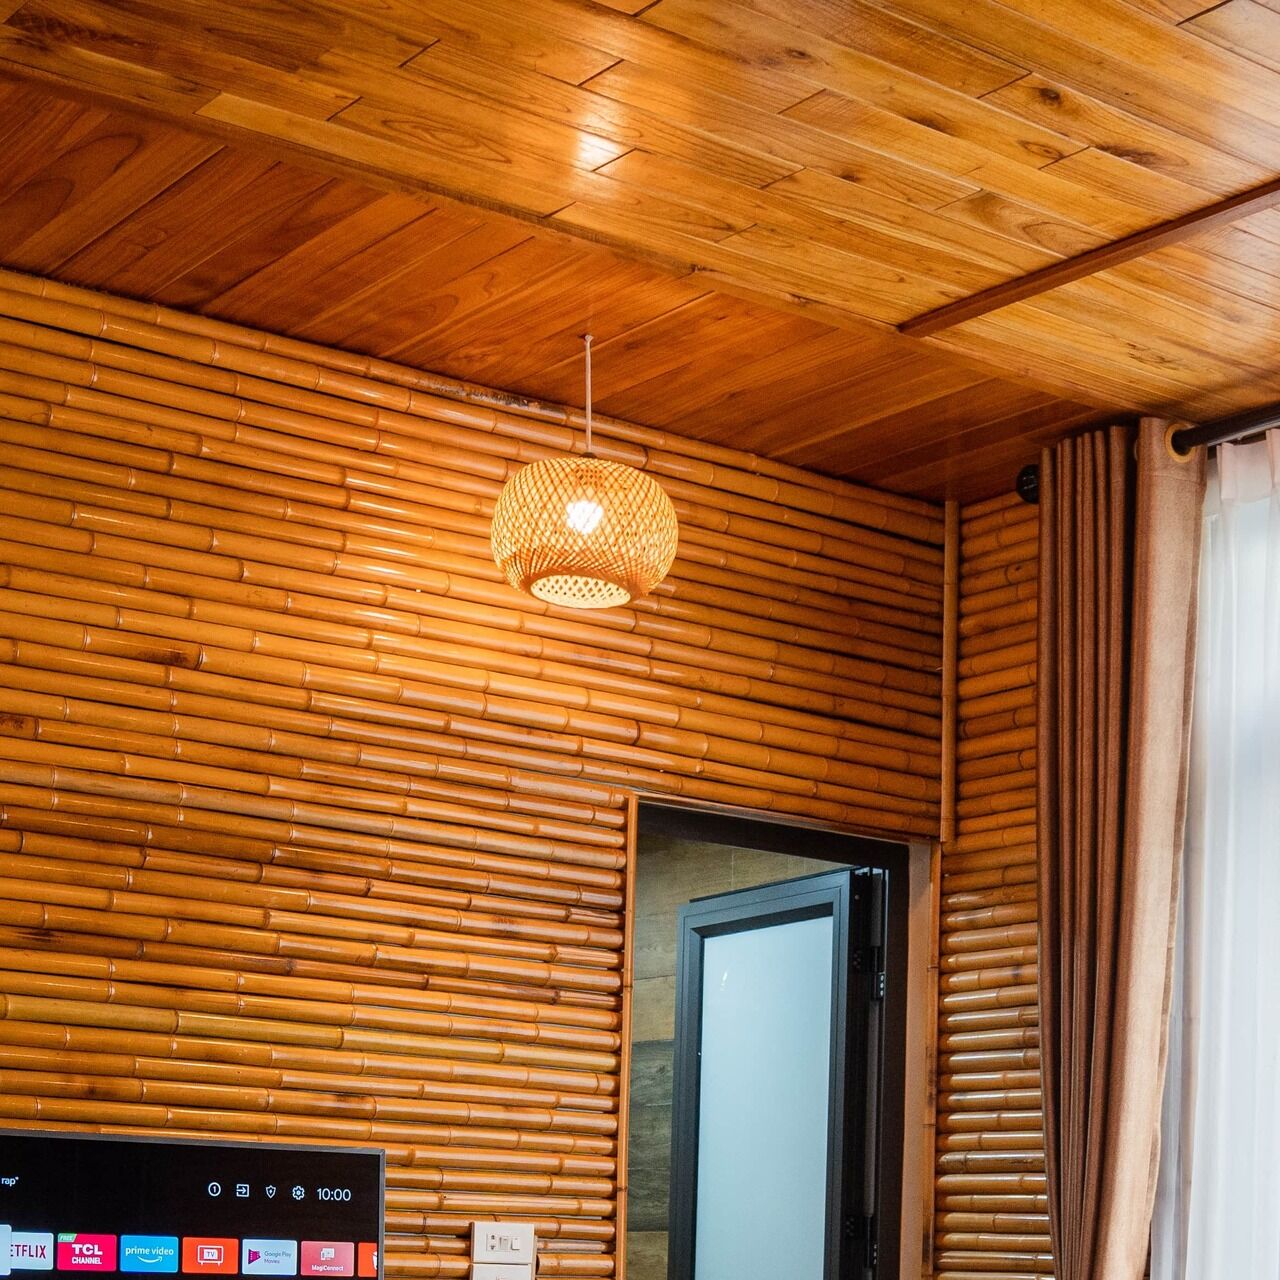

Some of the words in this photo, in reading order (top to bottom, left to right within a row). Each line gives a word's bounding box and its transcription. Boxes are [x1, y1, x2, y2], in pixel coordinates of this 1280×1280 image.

[316, 1187, 352, 1201] 10:00
[71, 1243, 103, 1255] TCL
[125, 1245, 150, 1256] prime
[151, 1246, 174, 1256] video
[71, 1257, 102, 1265] CHANNEL
